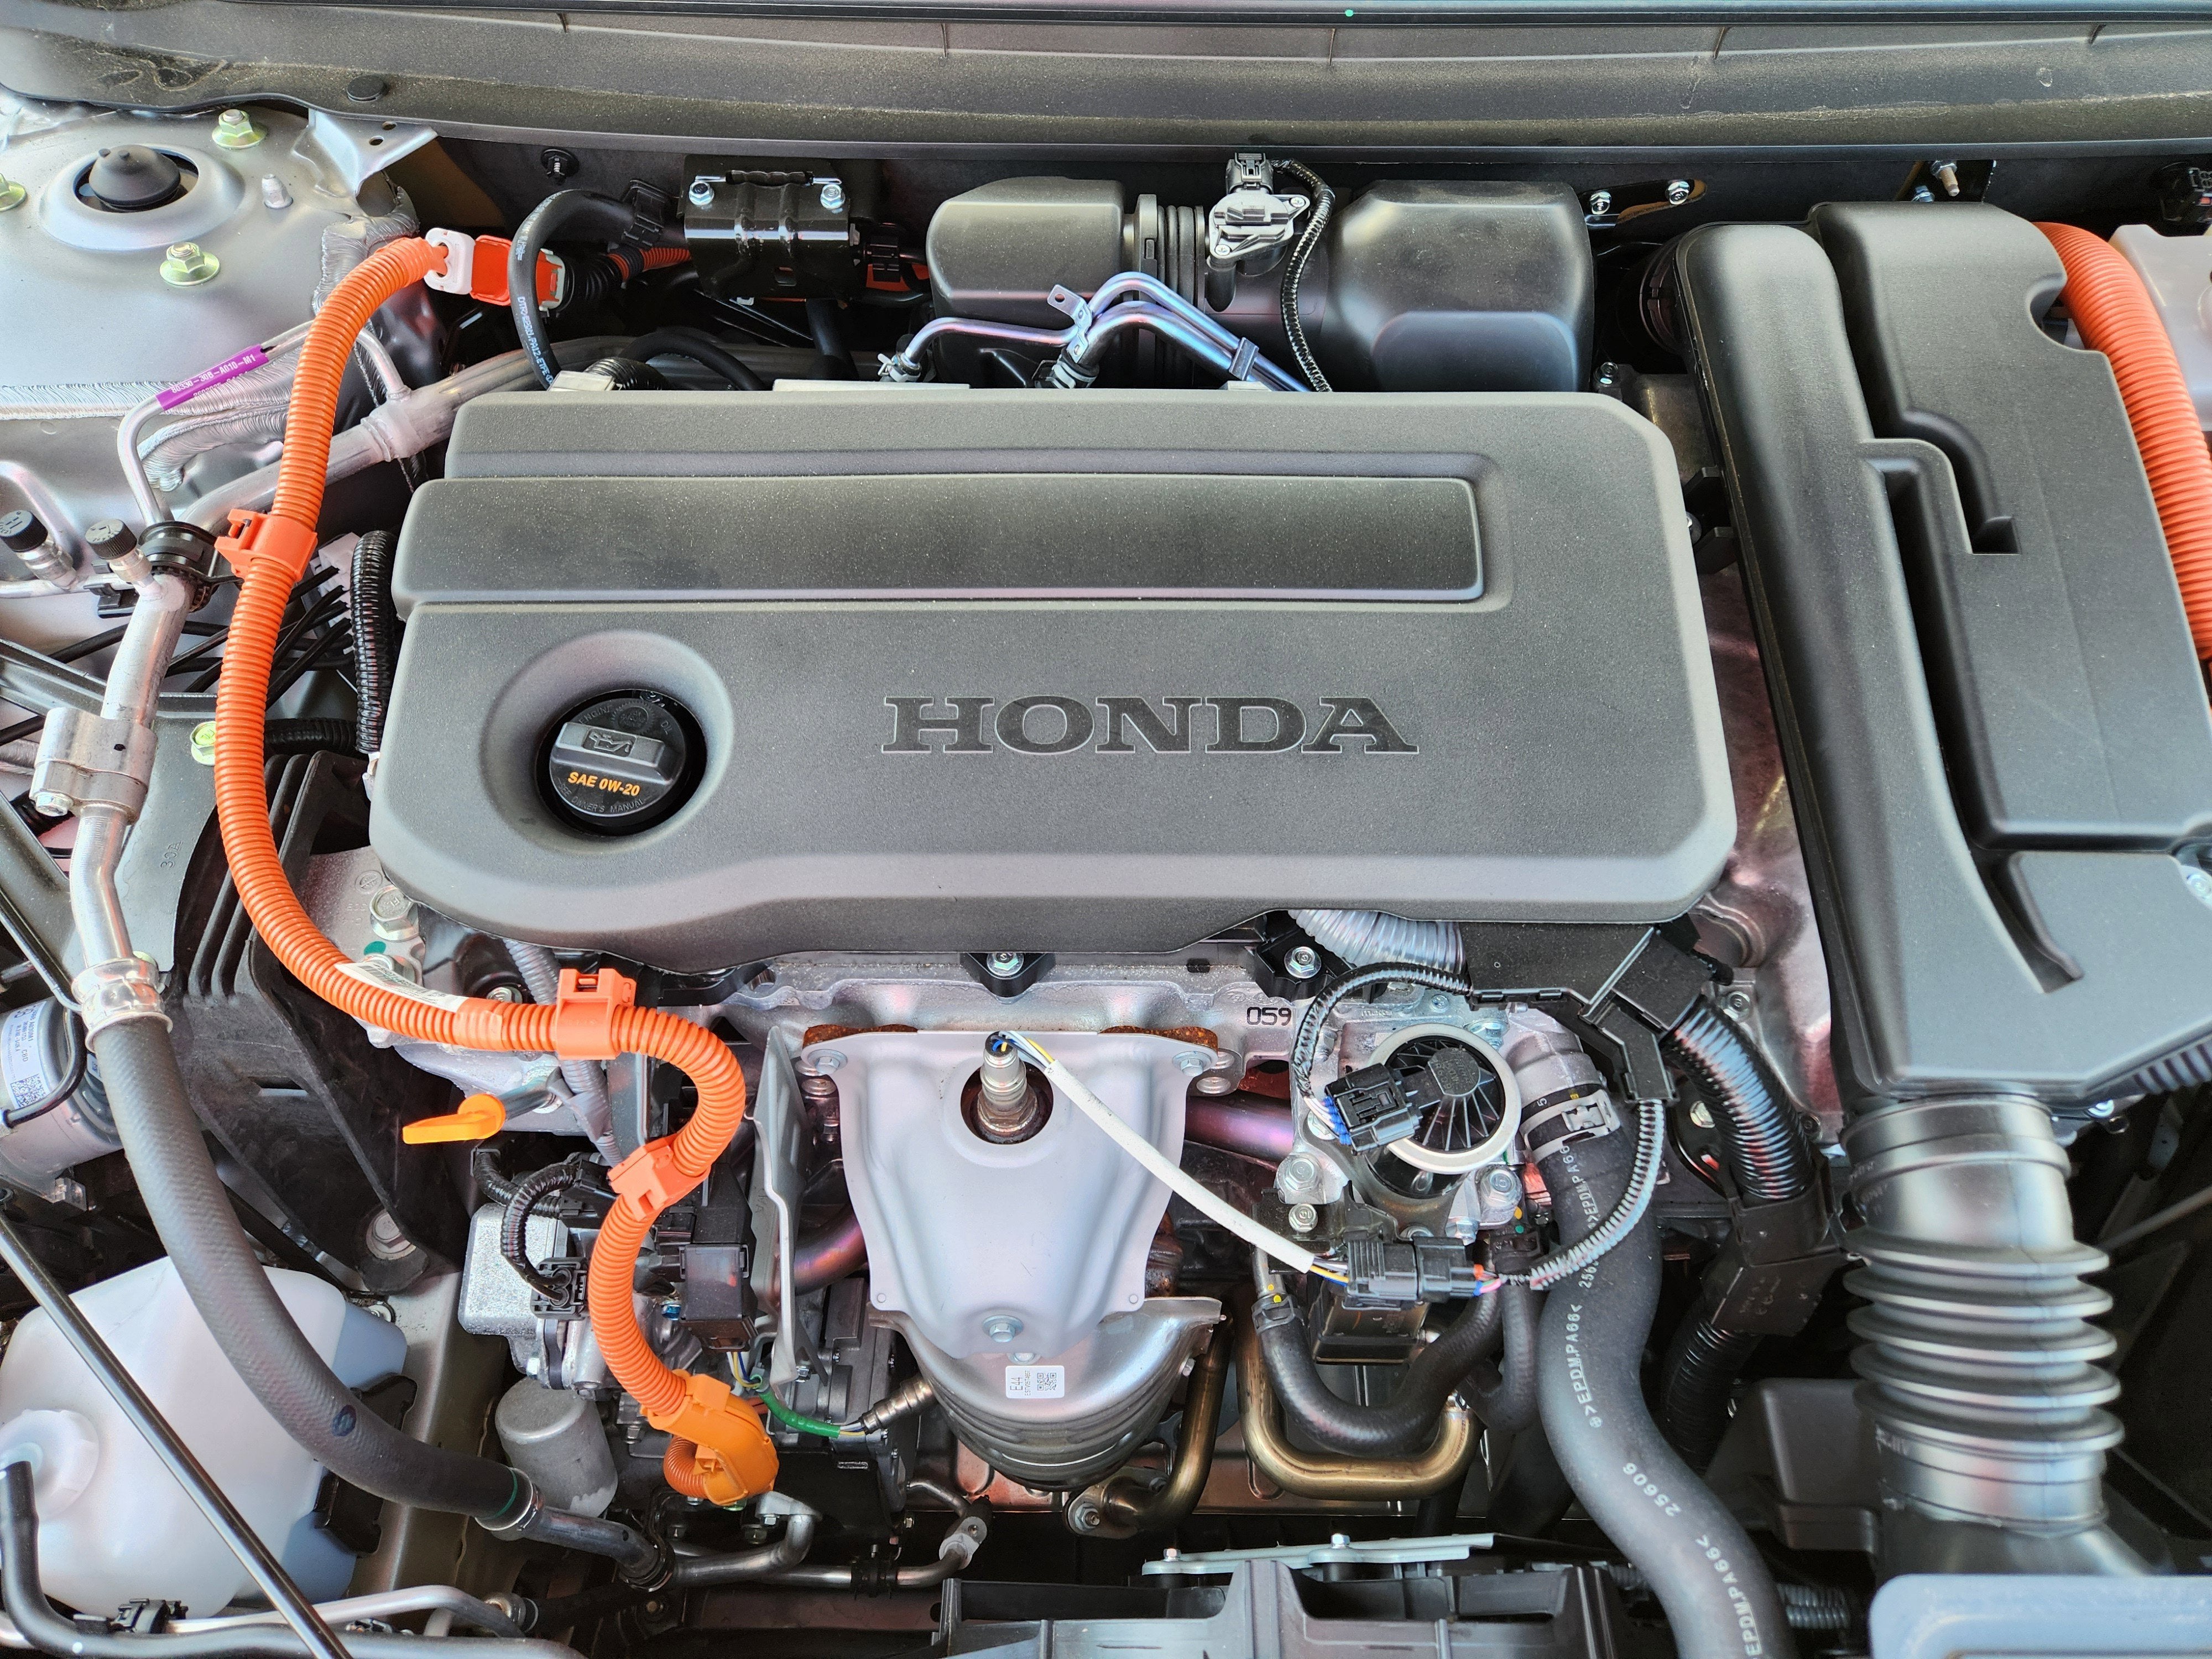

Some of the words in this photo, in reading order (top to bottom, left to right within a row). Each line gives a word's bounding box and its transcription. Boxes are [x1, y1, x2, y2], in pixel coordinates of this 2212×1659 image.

[881, 695, 1420, 755] HONDA
[567, 771, 598, 787] SAE
[599, 778, 641, 796] 0W-20
[558, 782, 572, 796] SEE
[571, 796, 605, 813] OWNER'S
[610, 799, 644, 813] MANUAL
[1246, 1006, 1292, 1026] 059
[1537, 1098, 1547, 1107] 5
[1010, 1377, 1023, 1391] E44
[1623, 1462, 1682, 1517] 25606
